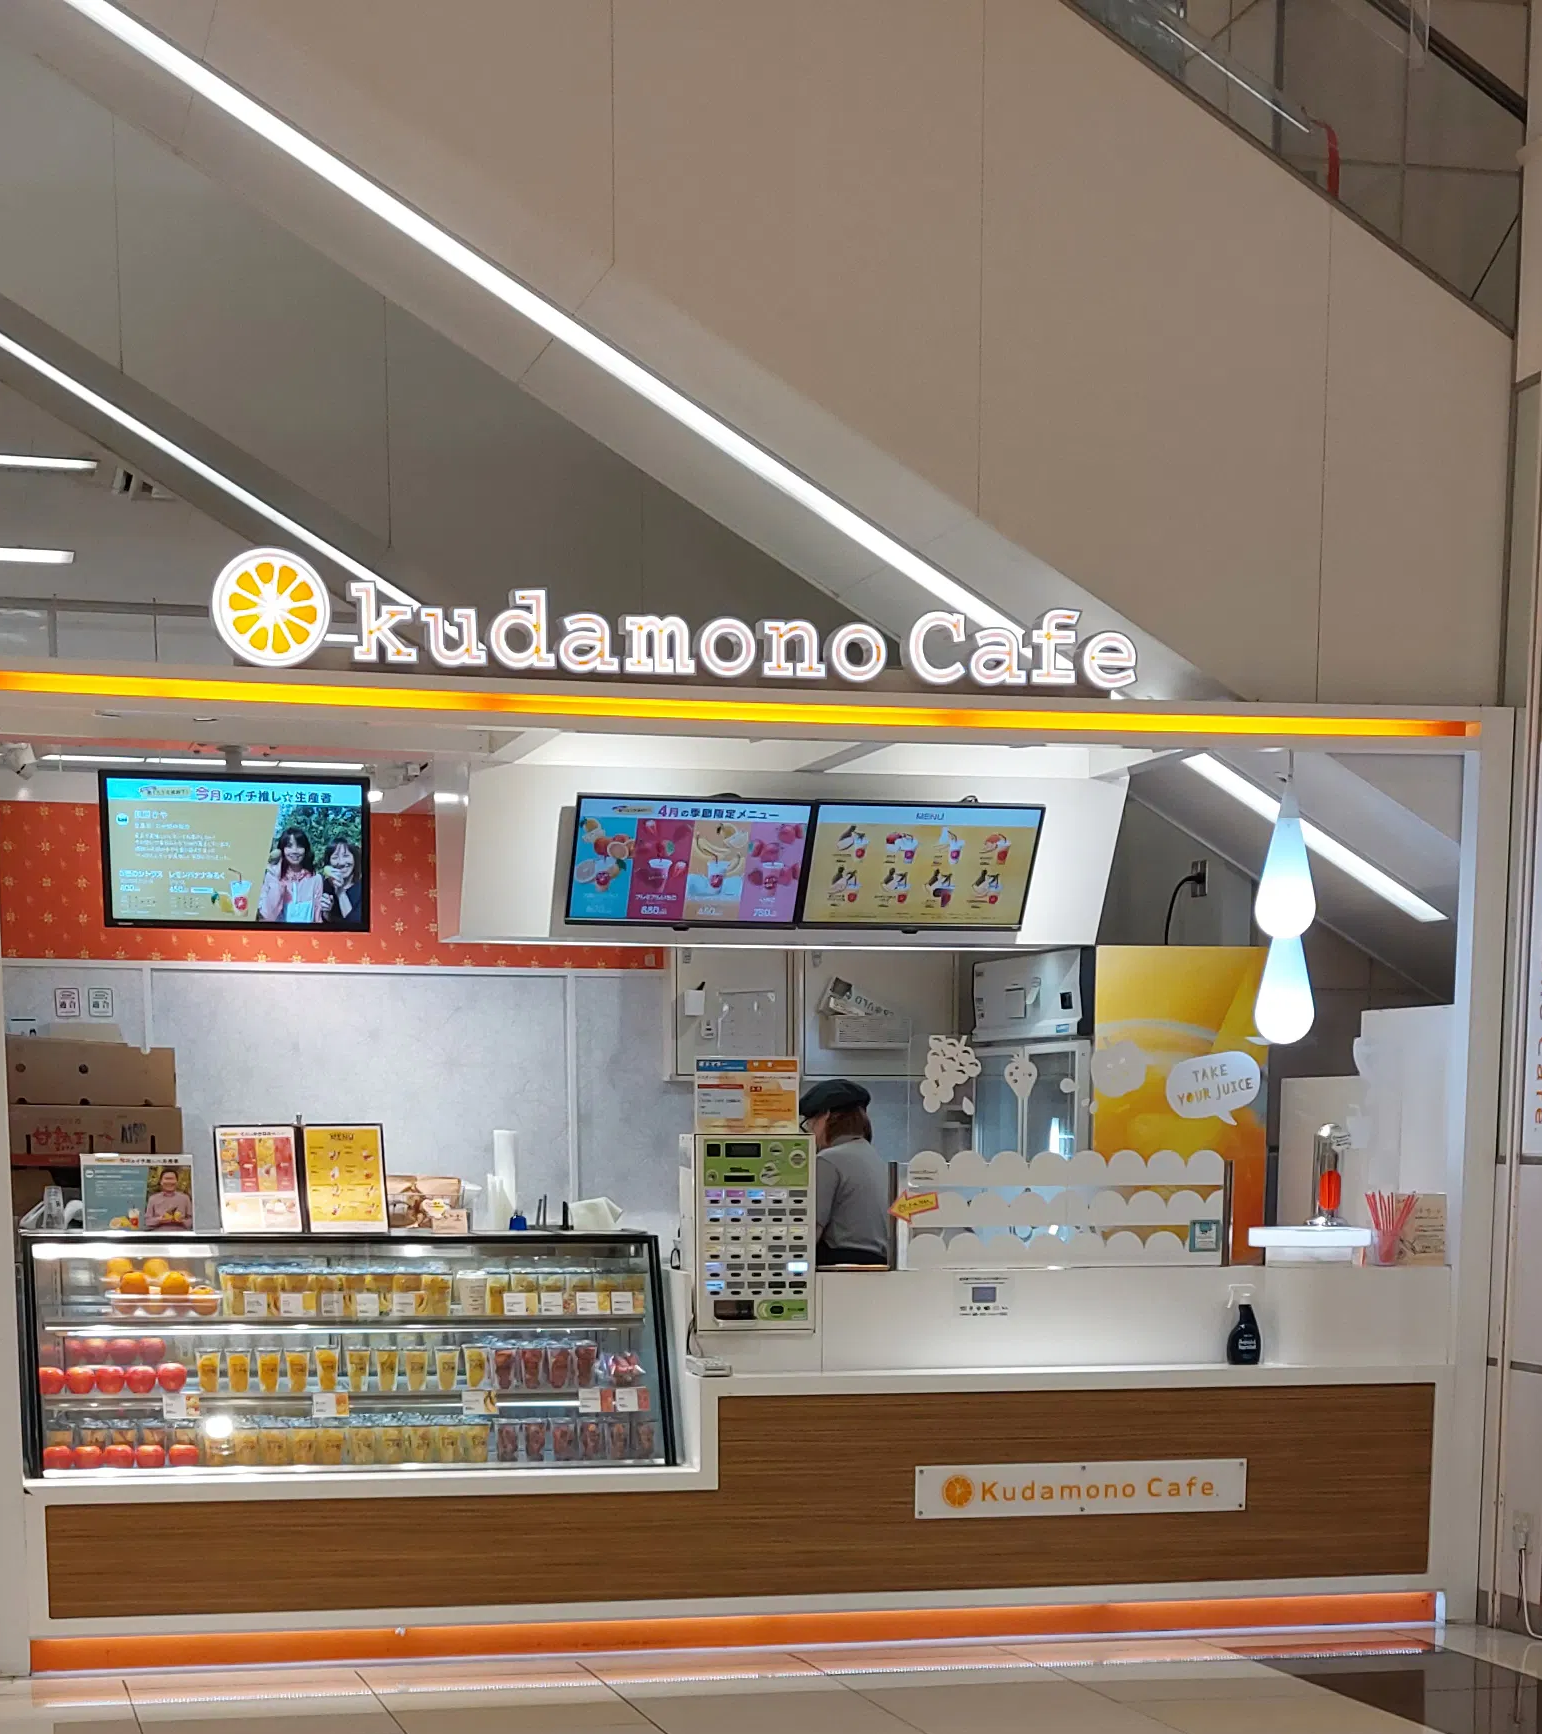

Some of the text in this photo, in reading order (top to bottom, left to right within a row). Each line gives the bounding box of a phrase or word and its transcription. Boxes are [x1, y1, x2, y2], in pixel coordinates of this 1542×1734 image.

[347, 580, 1140, 696] kudamono Cafe
[915, 811, 945, 821] MENU
[1192, 1063, 1230, 1084] TAKE
[1176, 1077, 1255, 1109] YOUR JUICE
[980, 1478, 1137, 1503] Kudamono
